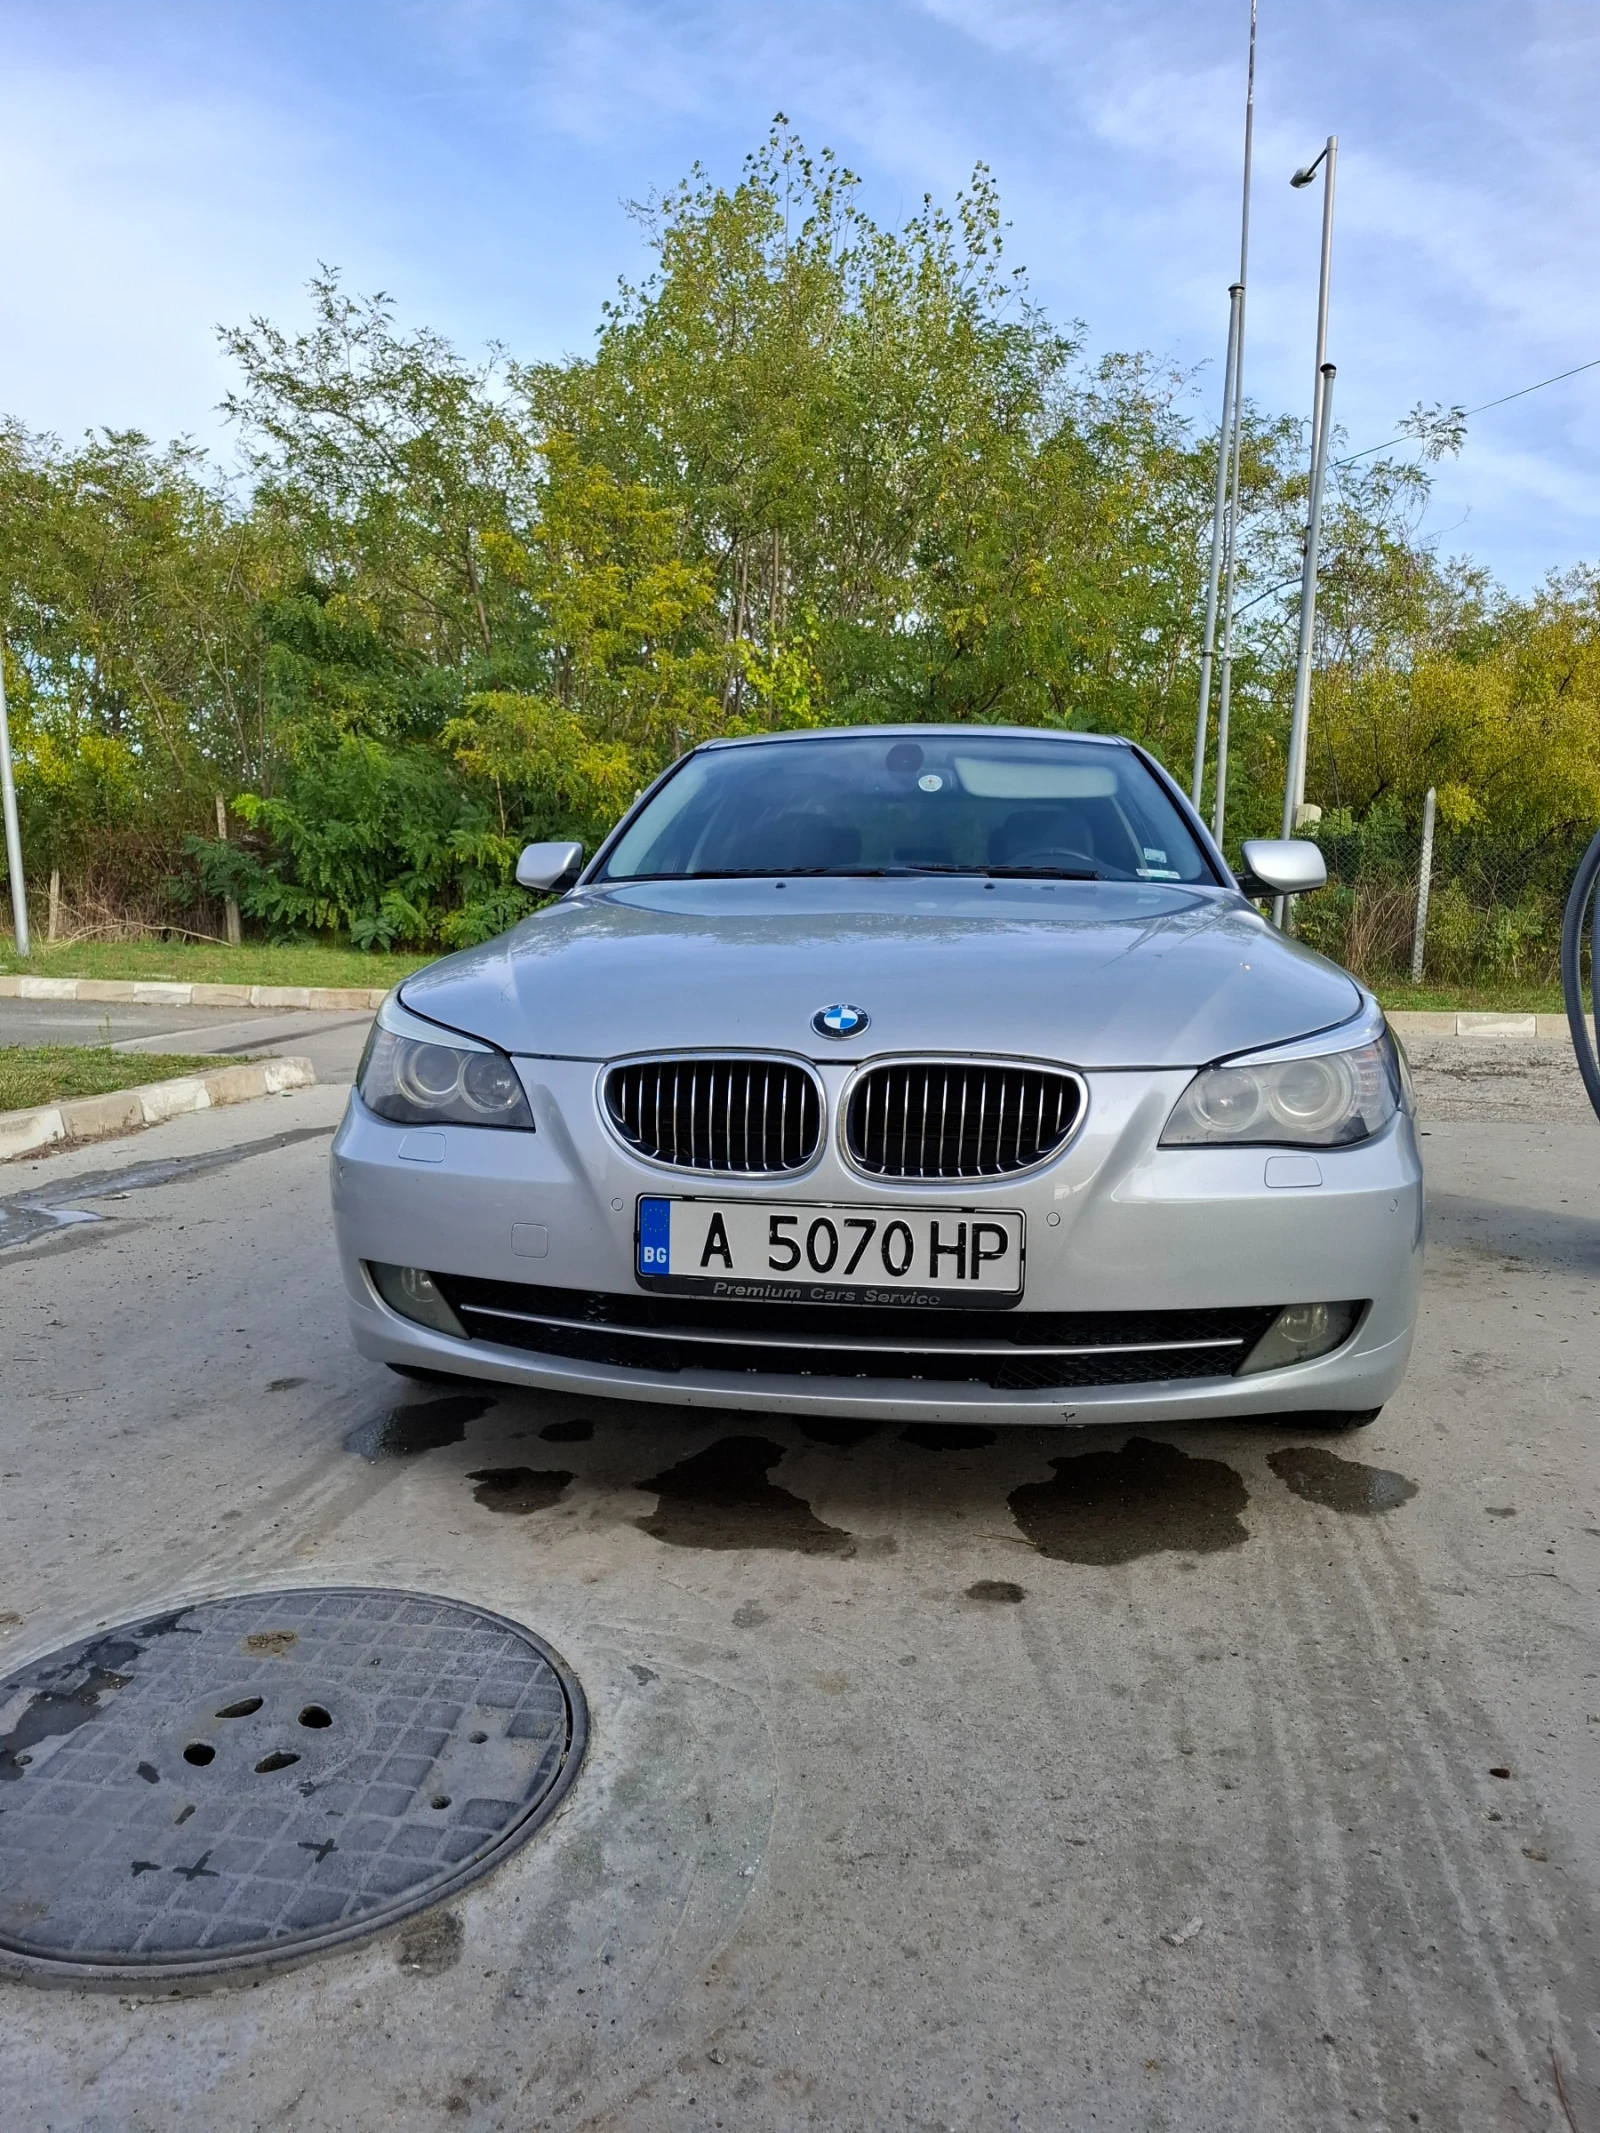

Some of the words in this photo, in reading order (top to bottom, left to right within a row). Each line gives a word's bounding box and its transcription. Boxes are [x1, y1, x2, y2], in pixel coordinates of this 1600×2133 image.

[820, 1004, 865, 1015] BMW
[644, 1246, 667, 1263] BG
[700, 1212, 733, 1268] A
[769, 1214, 914, 1277] 5070
[930, 1221, 1008, 1279] HP
[713, 1281, 801, 1298] Premium
[810, 1287, 856, 1301] Cars
